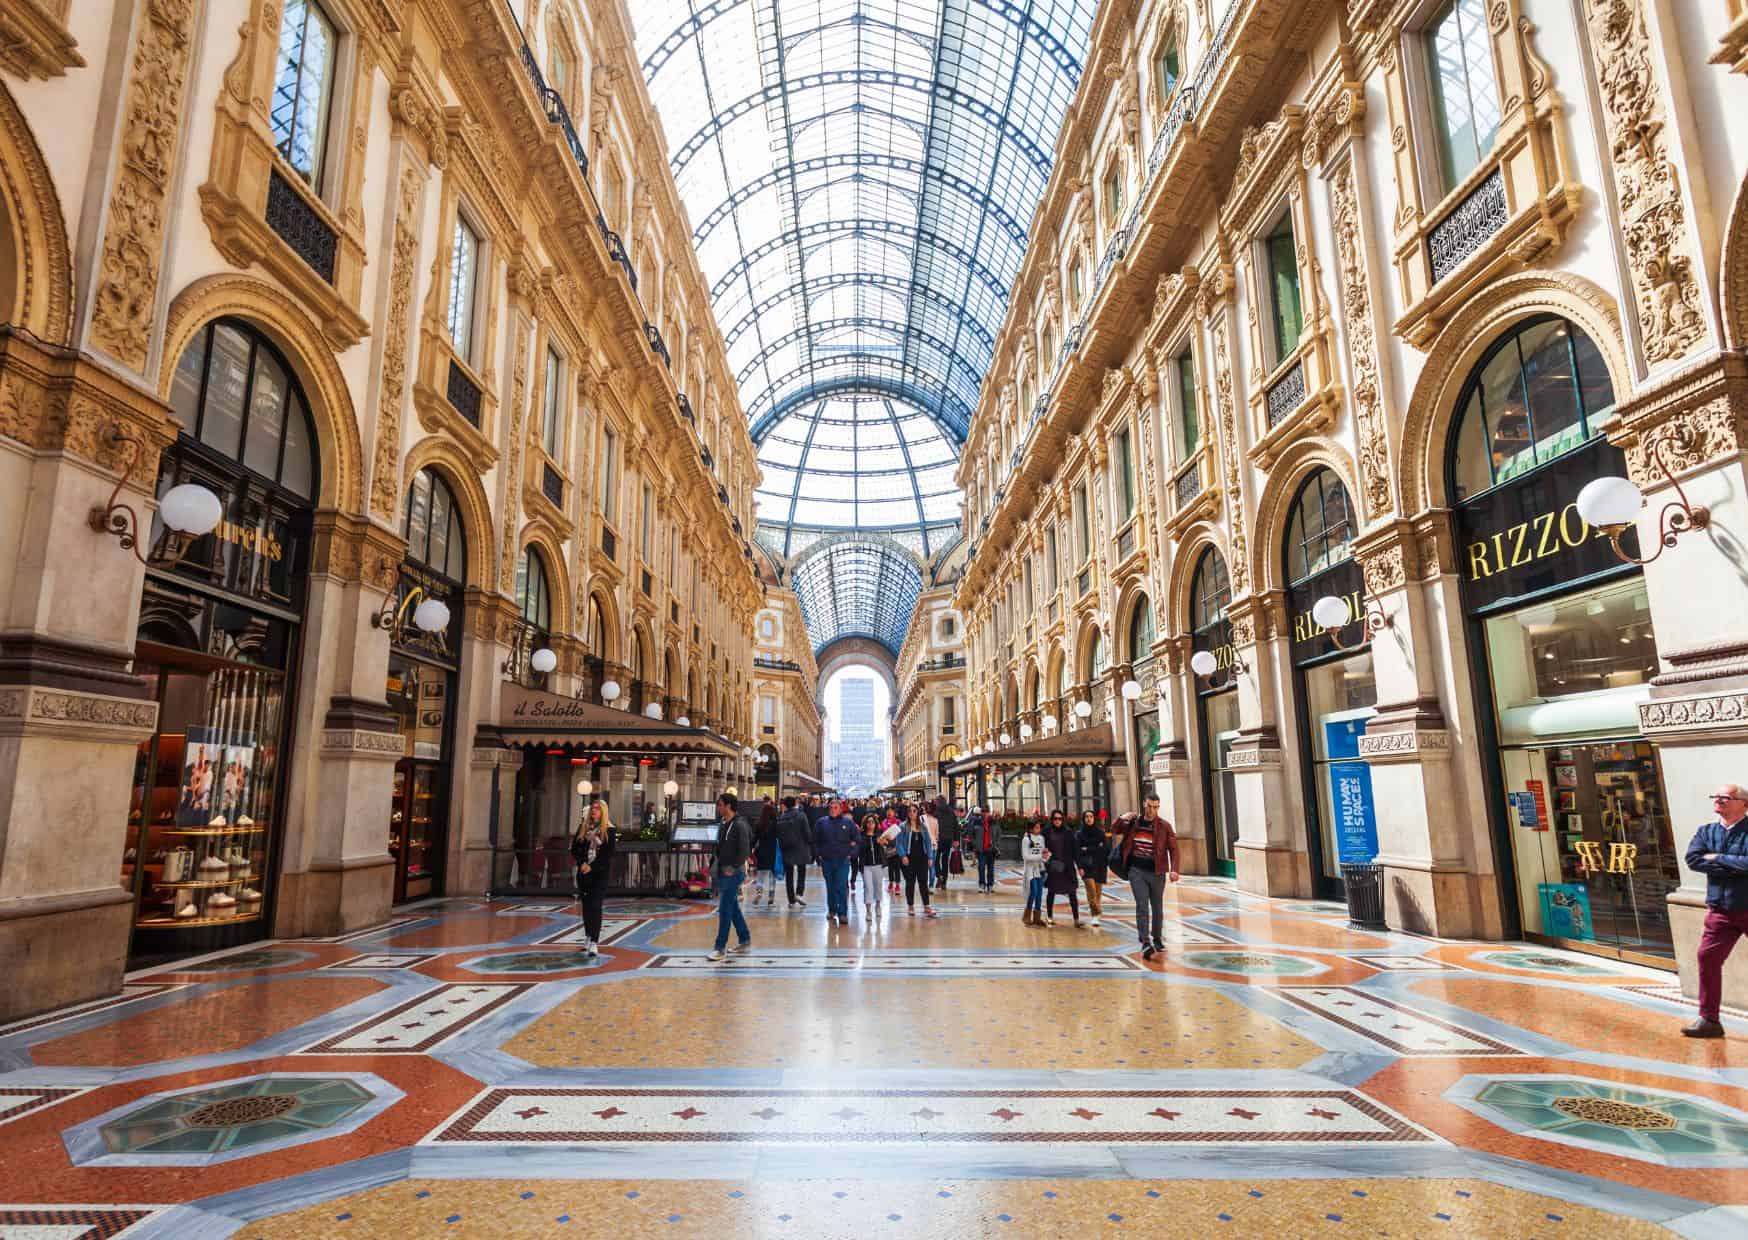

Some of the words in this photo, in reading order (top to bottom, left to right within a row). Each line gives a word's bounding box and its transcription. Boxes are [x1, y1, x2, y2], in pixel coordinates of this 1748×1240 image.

[215, 520, 282, 561] urch's
[1467, 503, 1637, 581] RIZZO
[514, 701, 528, 716] il
[531, 701, 584, 717] Salotto
[1340, 777, 1354, 826] HUMAN
[1351, 776, 1366, 827] SPACES
